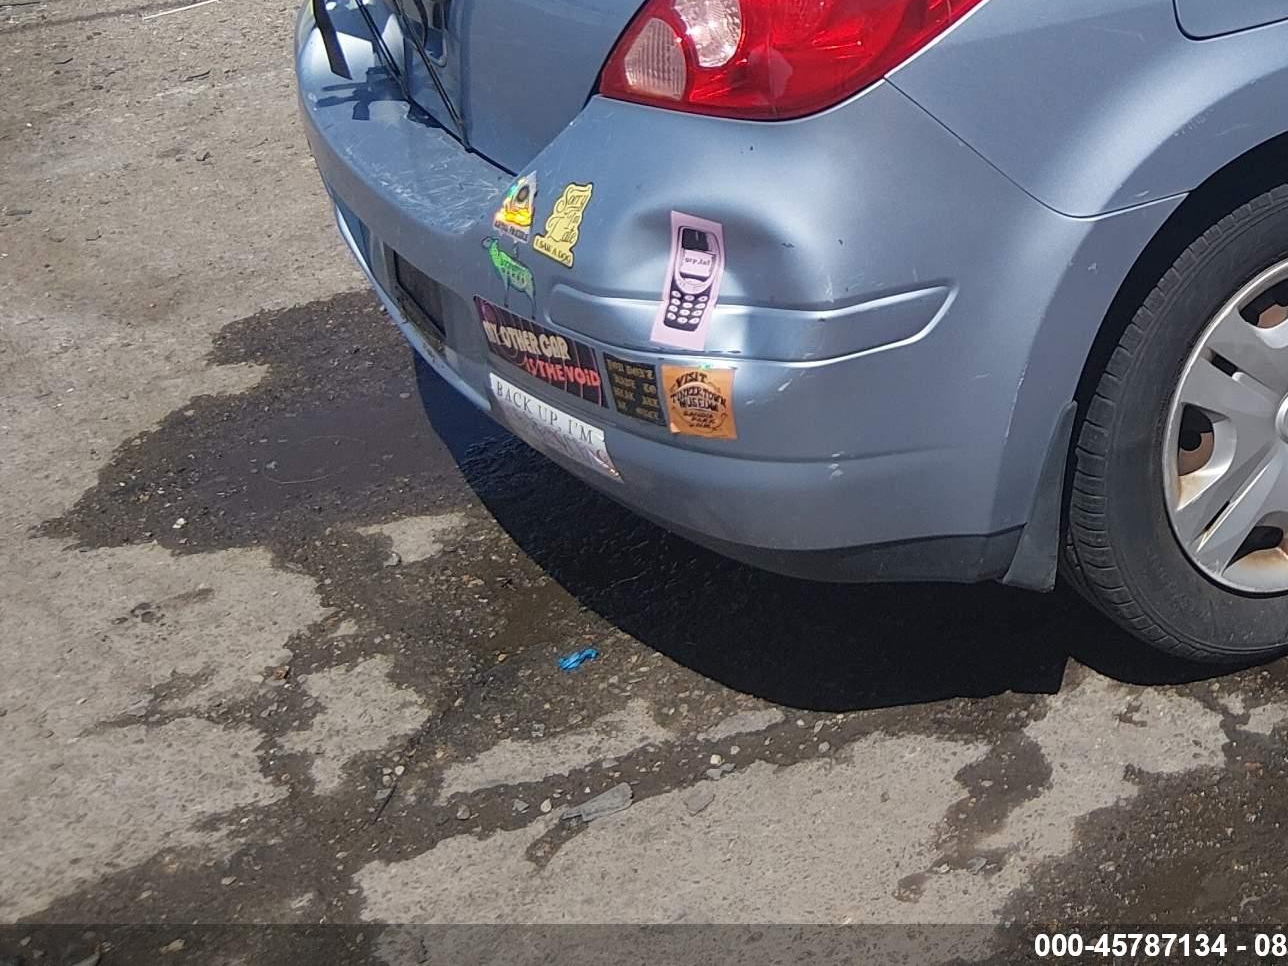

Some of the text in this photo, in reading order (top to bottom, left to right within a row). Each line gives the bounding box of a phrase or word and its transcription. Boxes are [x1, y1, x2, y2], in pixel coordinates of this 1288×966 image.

[483, 320, 571, 360] MY OTHER CAR
[537, 359, 565, 381] THE
[676, 371, 708, 388] VISIT
[496, 380, 533, 413] BACK
[568, 420, 593, 444] I'M
